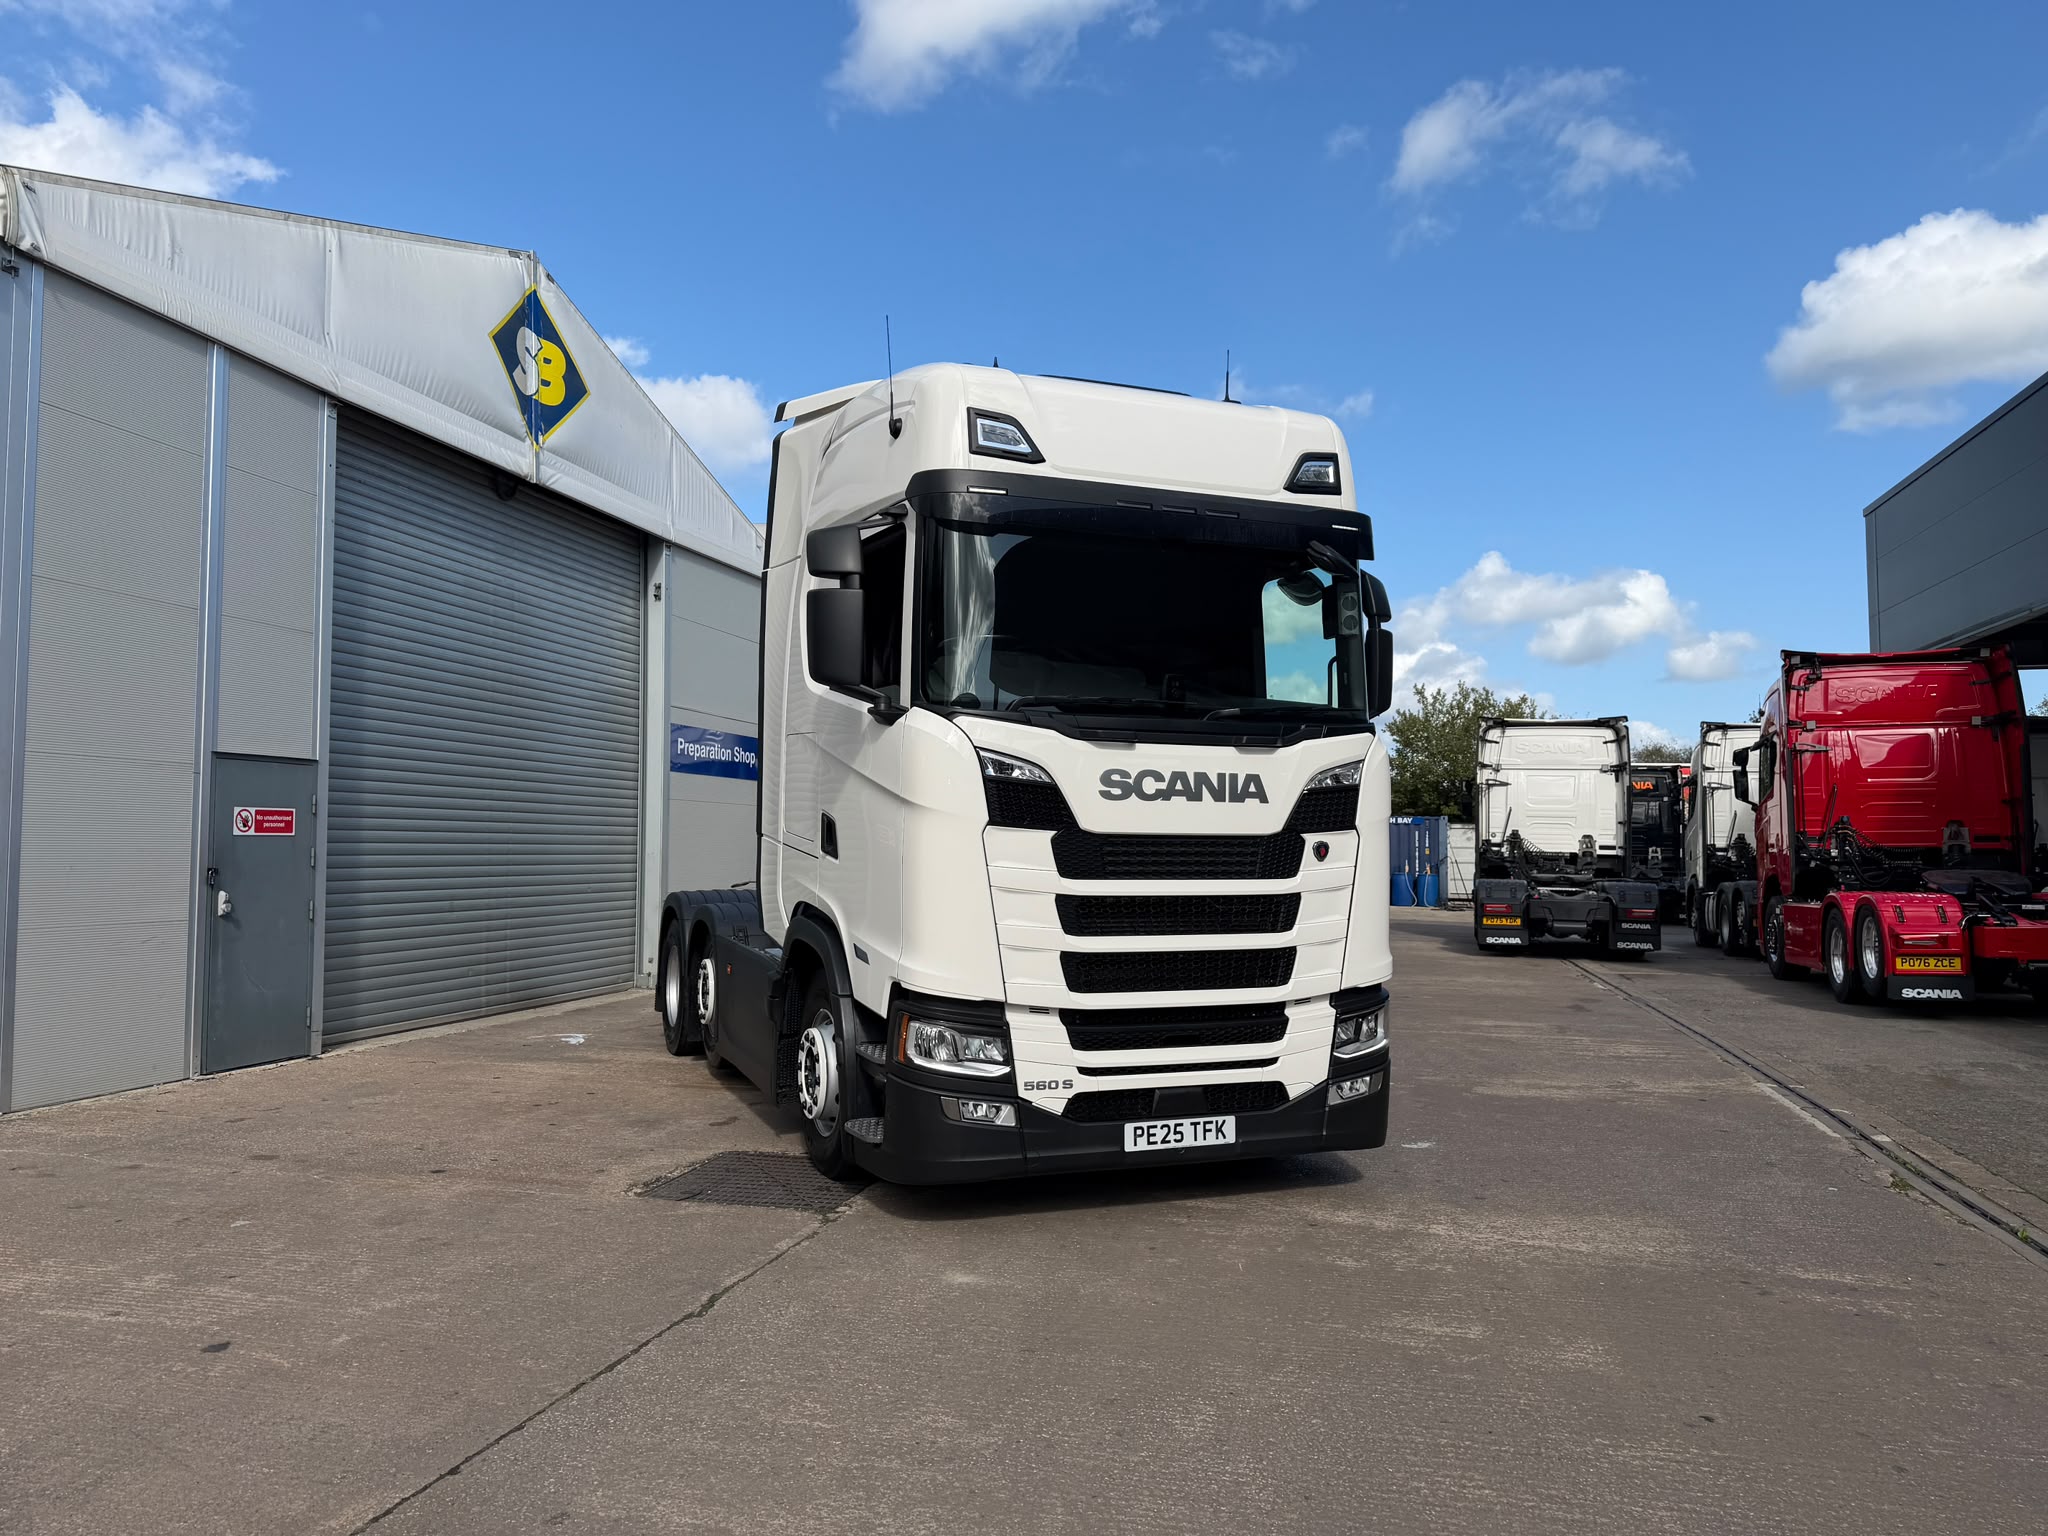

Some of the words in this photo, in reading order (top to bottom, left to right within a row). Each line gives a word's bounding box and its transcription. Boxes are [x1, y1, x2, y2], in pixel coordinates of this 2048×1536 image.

[512, 326, 566, 406] SB
[1835, 685, 1938, 703] SCA
[677, 737, 732, 761] Preparation
[733, 746, 756, 768] Shop
[1098, 768, 1270, 804] SCANIA
[1621, 922, 1652, 930] SCANIA
[1486, 936, 1522, 945] SCANIA
[1617, 941, 1654, 950] SCANIA
[1900, 957, 1931, 968] PO76
[1933, 957, 1956, 968] ZCE
[1901, 988, 1962, 999] SCANIA
[1023, 1080, 1059, 1091] 560
[1061, 1079, 1074, 1090] S
[1133, 1122, 1185, 1147] PE25
[1189, 1119, 1228, 1143] TFK
